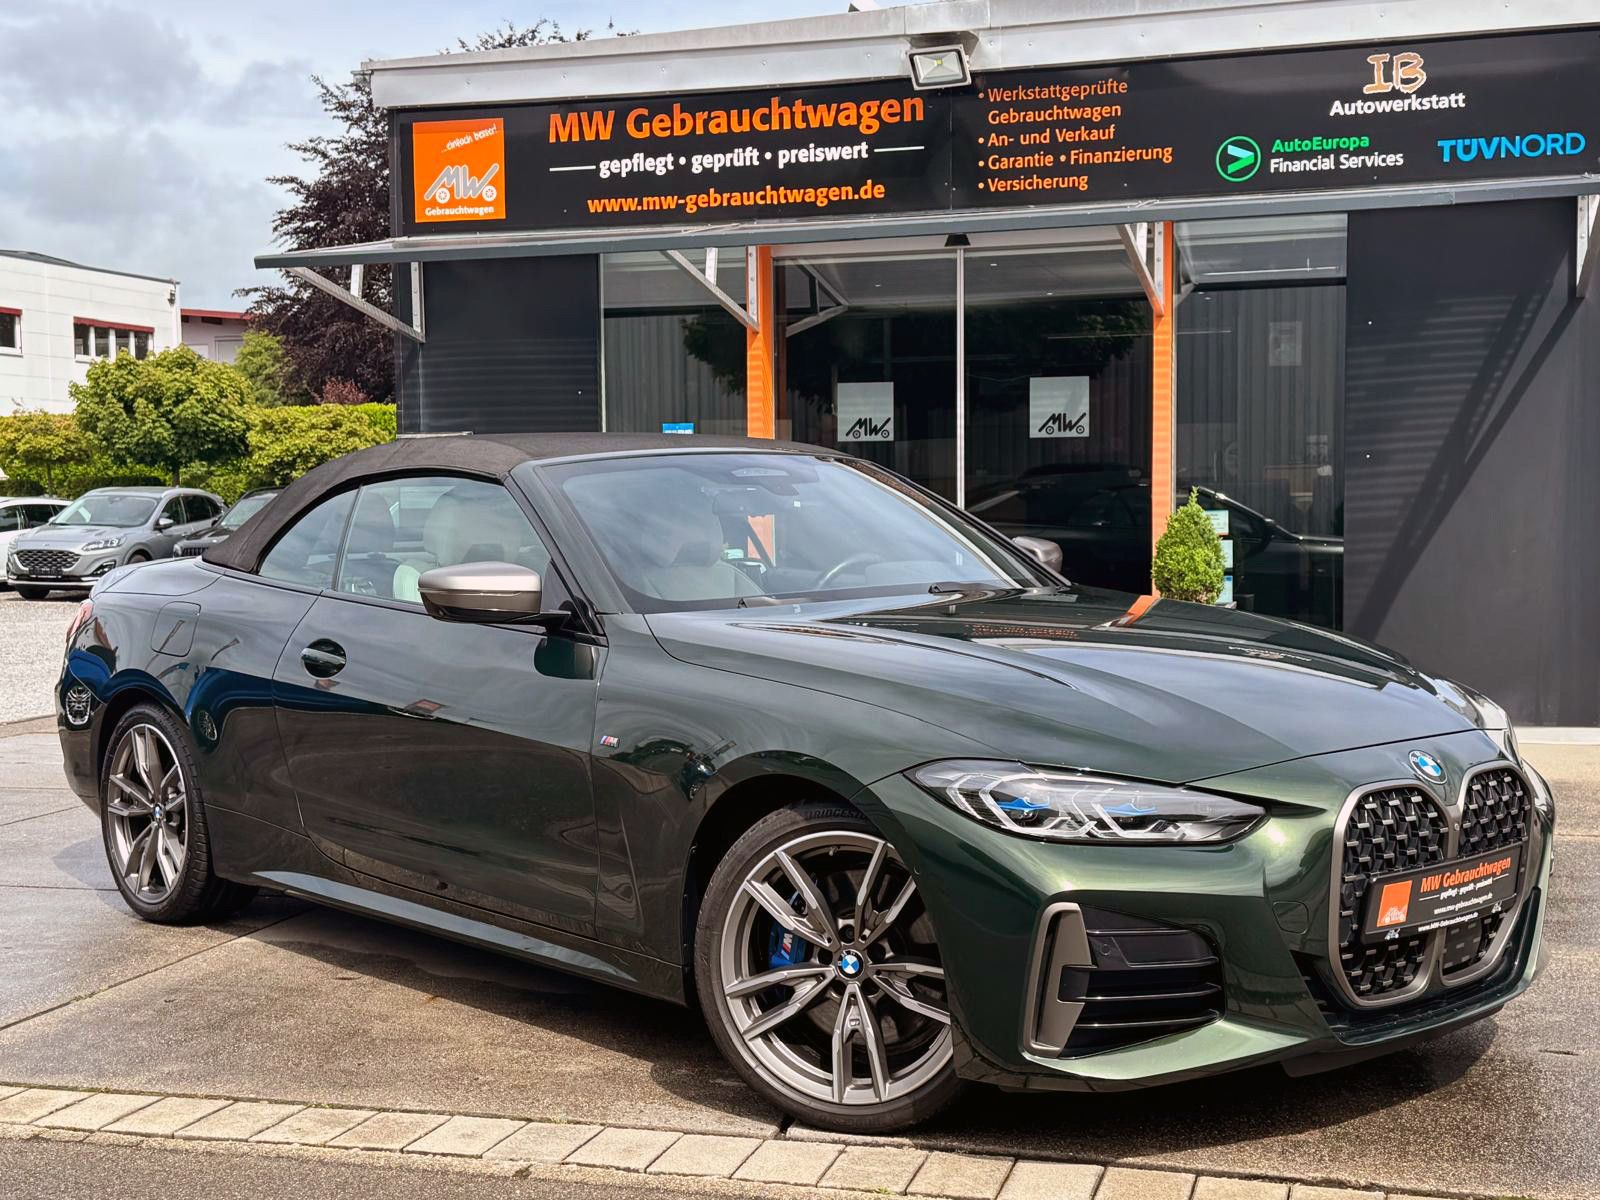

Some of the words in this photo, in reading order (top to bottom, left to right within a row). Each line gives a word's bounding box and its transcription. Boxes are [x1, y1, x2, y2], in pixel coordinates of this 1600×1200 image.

[1363, 52, 1427, 94] IB
[988, 80, 1128, 102] Werkstattgeprüfte
[988, 102, 1122, 125] Gebrauchtwagen
[1330, 92, 1466, 117] Autowerkstatt
[549, 111, 614, 143] MW
[627, 96, 925, 137] Gebrauchtwagen
[988, 133, 1014, 147] An-
[1020, 129, 1049, 145] und
[1056, 124, 1116, 142] Verkauf
[1271, 135, 1370, 153] AutoEuropa
[599, 152, 674, 179] gepflegt
[691, 146, 759, 173] geprüft
[778, 141, 869, 169] preiswert
[988, 151, 1054, 170] Garantie
[1070, 143, 1173, 165] Finanzierung
[1270, 155, 1350, 173] Financial
[1354, 150, 1404, 168] Services
[988, 174, 1089, 192] Versicherung
[587, 180, 886, 214] www.mw-gebrauchtwagen.de
[425, 205, 495, 217] Gebrauchtwagen
[1420, 874, 1442, 893] MW
[1443, 857, 1511, 888] Gebrauchtwagen
